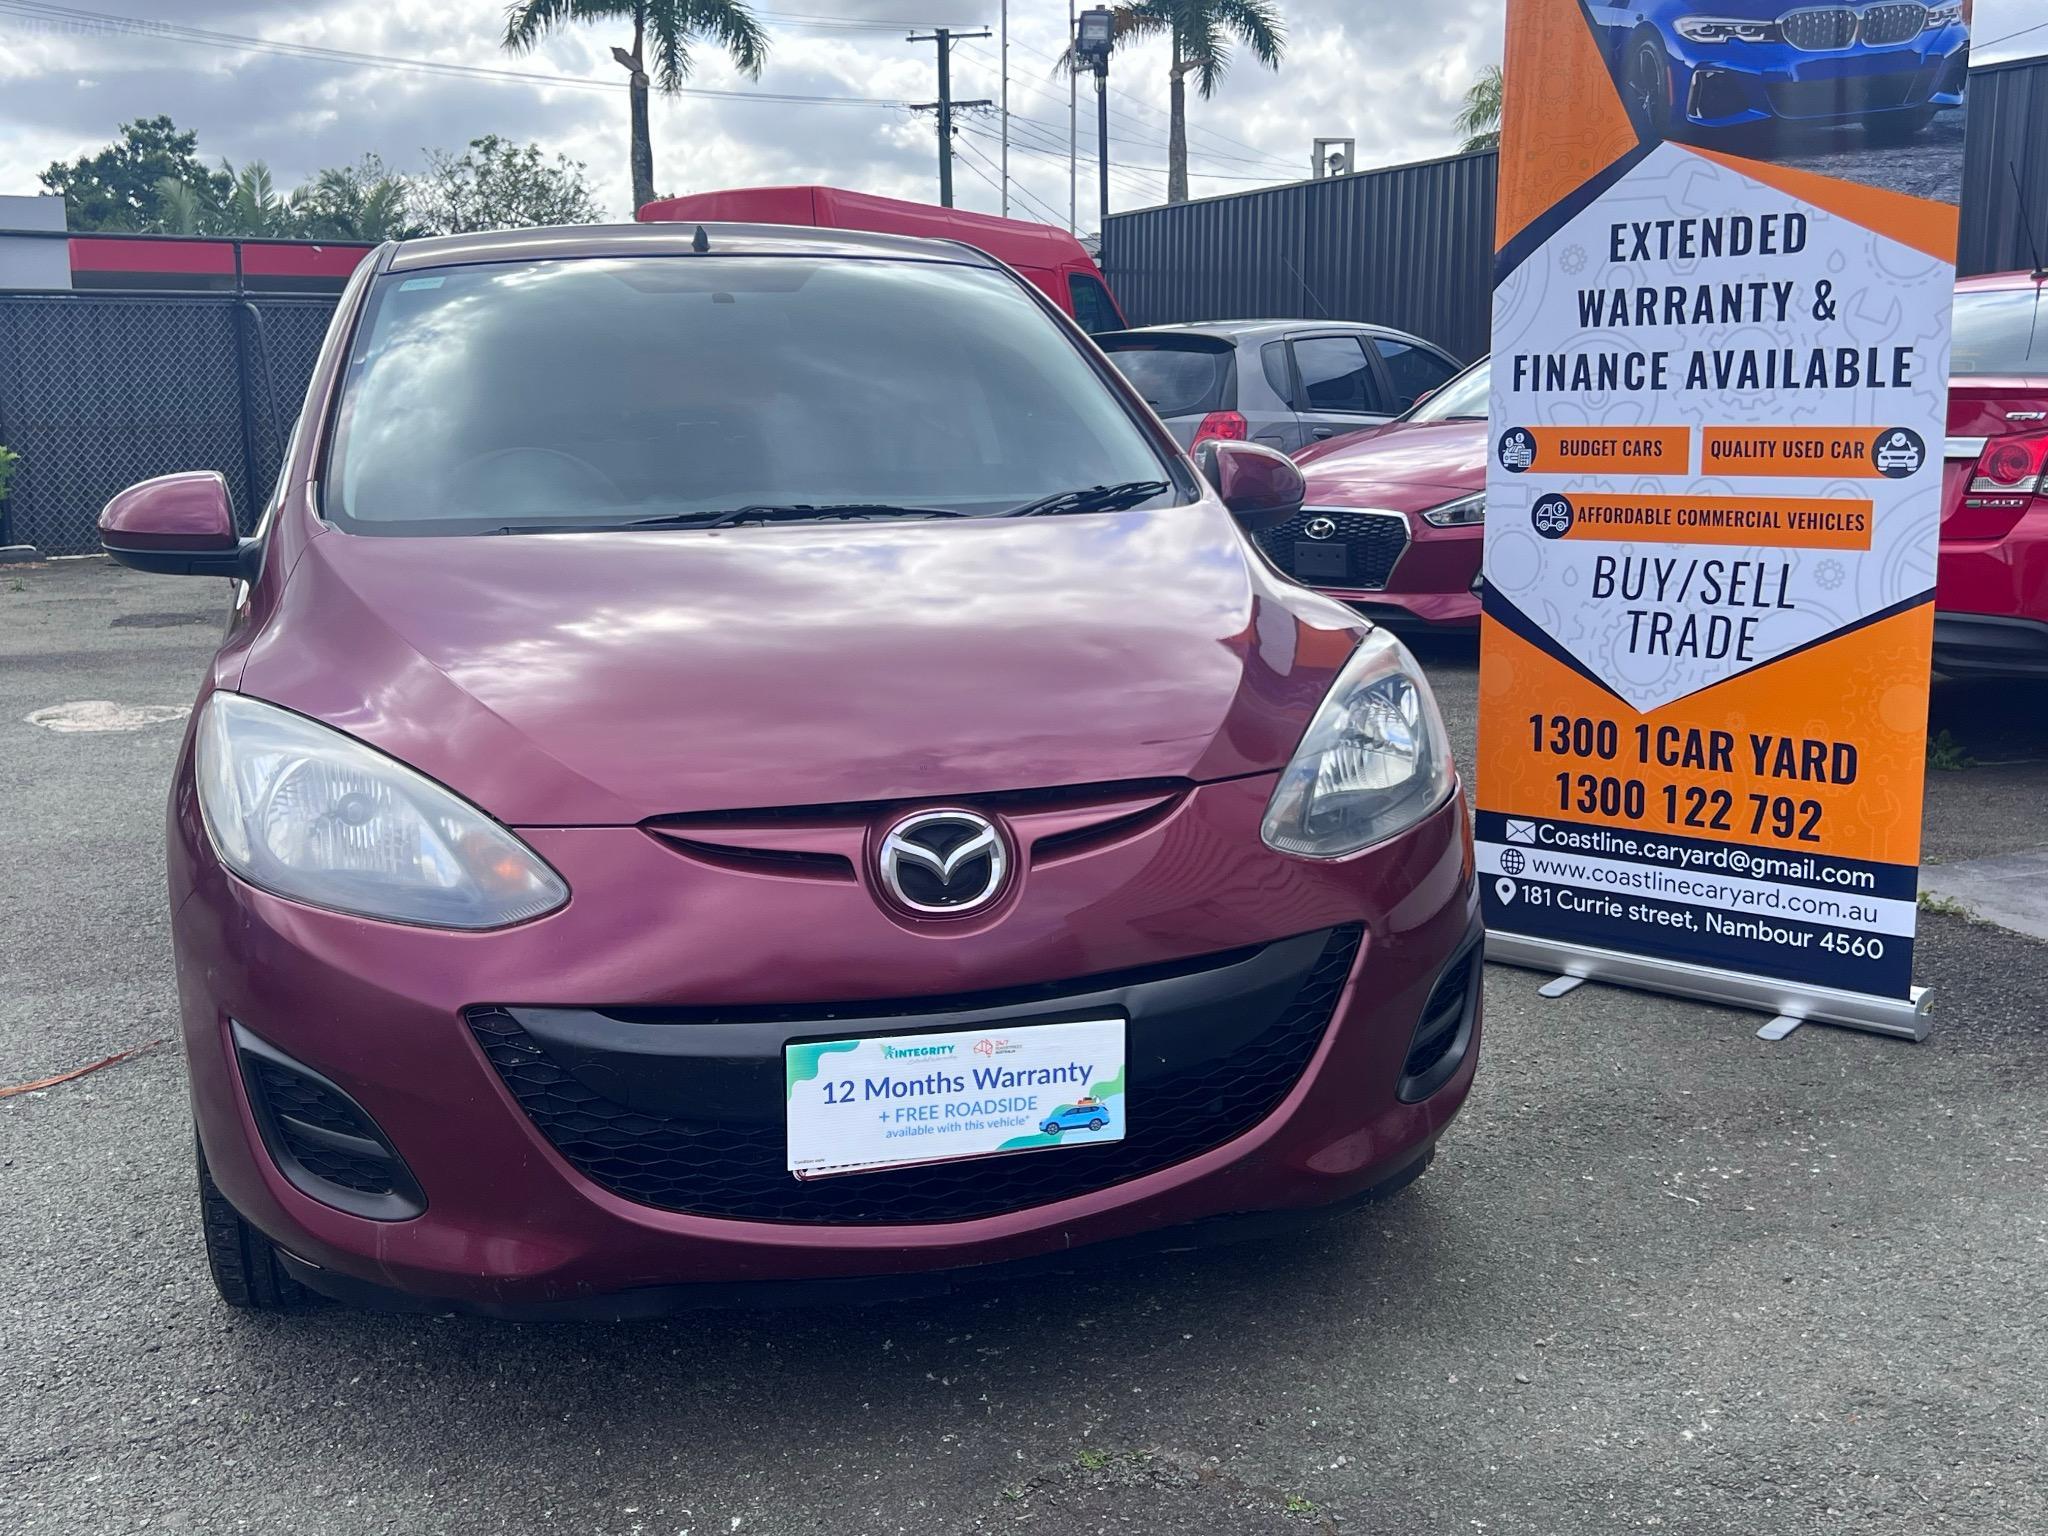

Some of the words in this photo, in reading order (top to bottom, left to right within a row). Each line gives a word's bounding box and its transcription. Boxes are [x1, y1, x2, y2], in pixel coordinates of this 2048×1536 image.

[1609, 212, 1807, 263] EXTENDED
[1577, 280, 1794, 328] WARRANTY
[1811, 279, 1836, 322] &
[1513, 350, 1667, 392] FINANCE
[1685, 346, 1914, 390] AVAILABLE
[1559, 439, 1618, 457] BUDGET
[1622, 439, 1663, 458] CARS
[1710, 440, 1777, 460] QUALITY
[1782, 440, 1824, 459] USED
[1830, 440, 1865, 460] CAR
[1577, 506, 1672, 526] AFFORDABLE
[1676, 508, 1781, 530] COMMERCIAL
[1787, 511, 1865, 532] VEHICLES
[1592, 555, 1796, 610] BUY/SELL
[1626, 609, 1759, 662] TRADE
[1529, 713, 1618, 760] 1300
[1634, 723, 1734, 774] 1CAR
[1750, 734, 1858, 786] YARD
[1556, 772, 1645, 819] 1300
[1662, 784, 1733, 831] 122
[1749, 793, 1823, 843] 792
[1538, 824, 1875, 889] Coastline.caryard@gmail.com
[1532, 856, 1878, 924] www.coastlinecaryard.com.au
[1521, 885, 1552, 908] 181
[1556, 889, 1622, 918] Currie
[1628, 903, 1698, 933] street,
[1706, 912, 1814, 949] Nambour
[1819, 931, 1884, 961] 4560
[893, 1044, 956, 1059] INTEGRITY
[822, 1080, 855, 1105] 12
[864, 1070, 965, 1101] Months
[972, 1061, 1094, 1091] Warranty
[879, 1111, 891, 1123] +
[895, 1106, 939, 1123] FREE
[944, 1096, 1038, 1119] ROADSIDE
[885, 1124, 935, 1139] available
[937, 1121, 962, 1134] with
[965, 1118, 985, 1131] this
